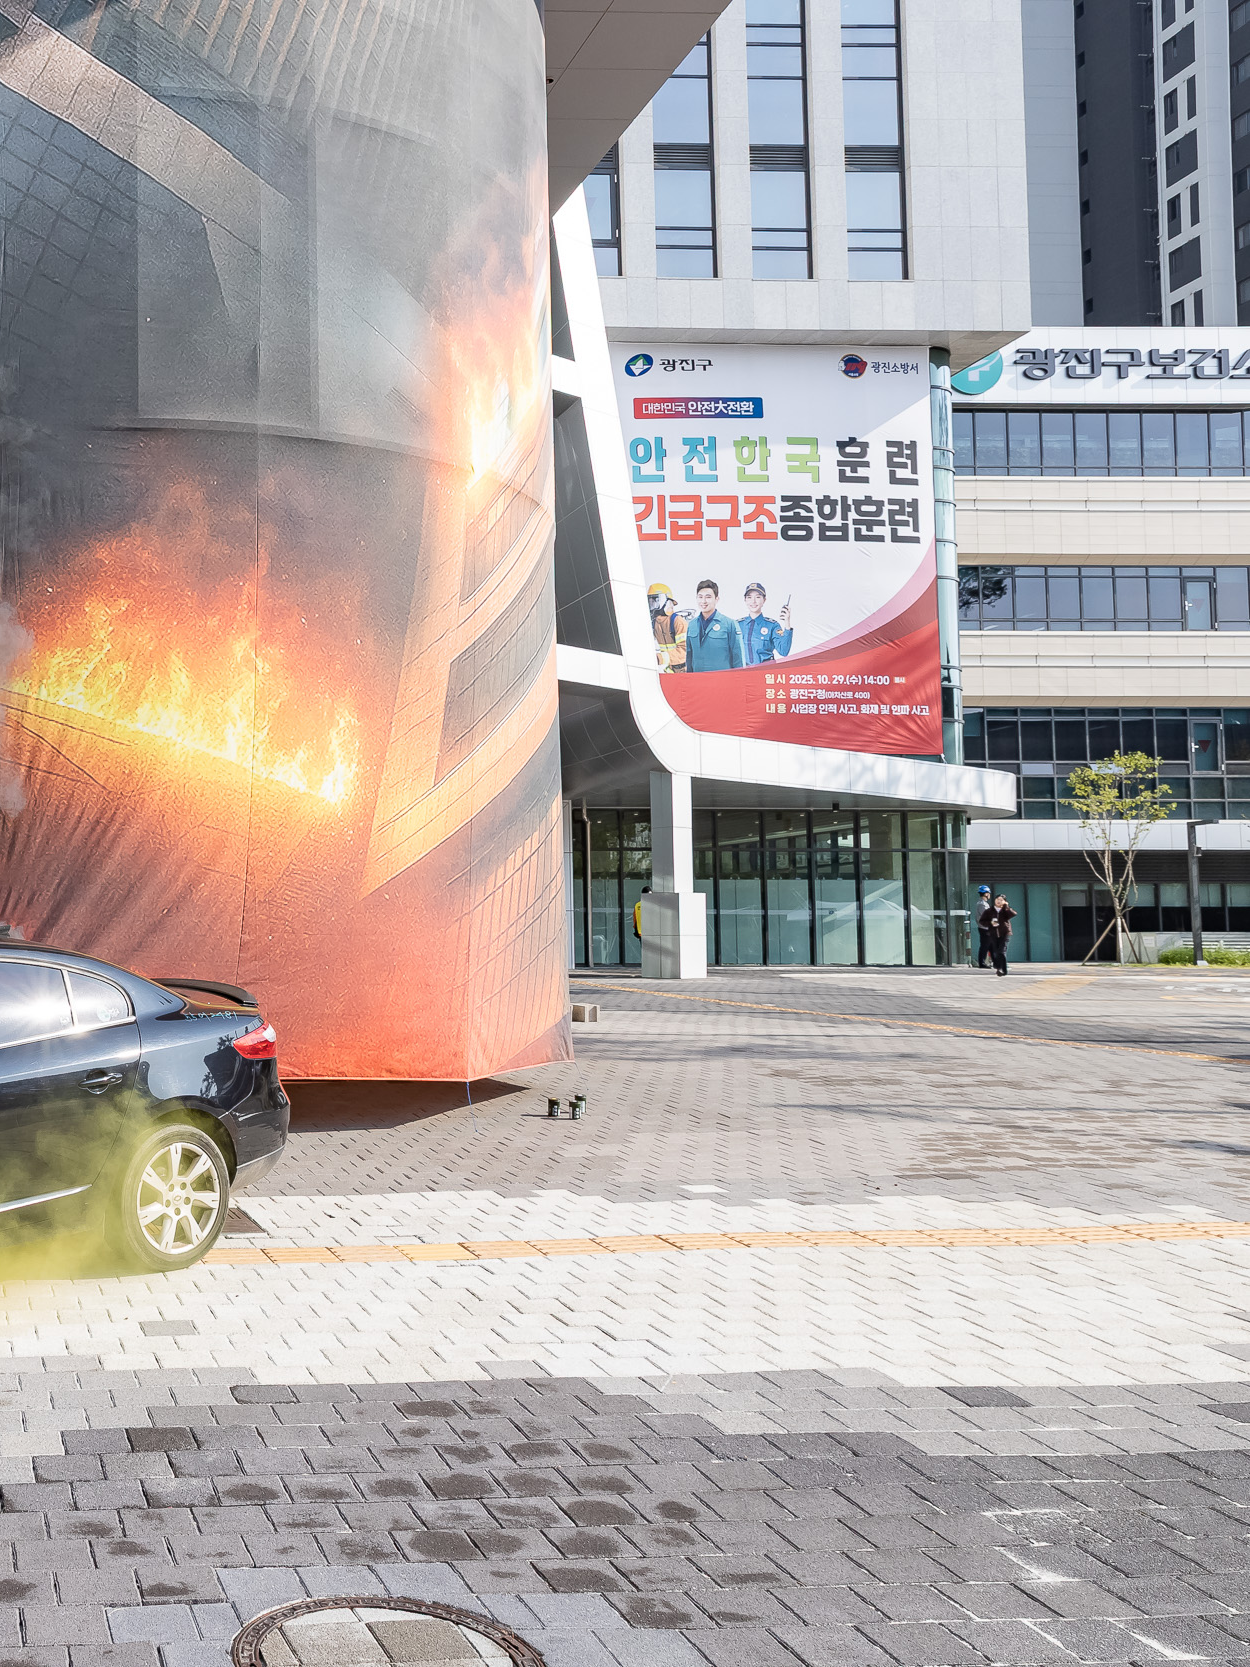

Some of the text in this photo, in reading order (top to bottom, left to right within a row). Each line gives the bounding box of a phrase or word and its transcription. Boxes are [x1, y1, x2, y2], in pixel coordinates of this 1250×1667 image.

[659, 359, 713, 371] 광진구
[870, 361, 919, 375] 광진소방서
[642, 400, 754, 415] 대한민국 안전大전환
[632, 494, 921, 544] 긴급구조종합훈련
[789, 674, 816, 685] 2025.
[817, 674, 831, 685] 10.
[863, 675, 890, 685] 14:00
[790, 703, 817, 715] 사업장
[818, 703, 837, 714] 인적
[860, 704, 879, 715] 화재
[911, 705, 930, 716] 사고
